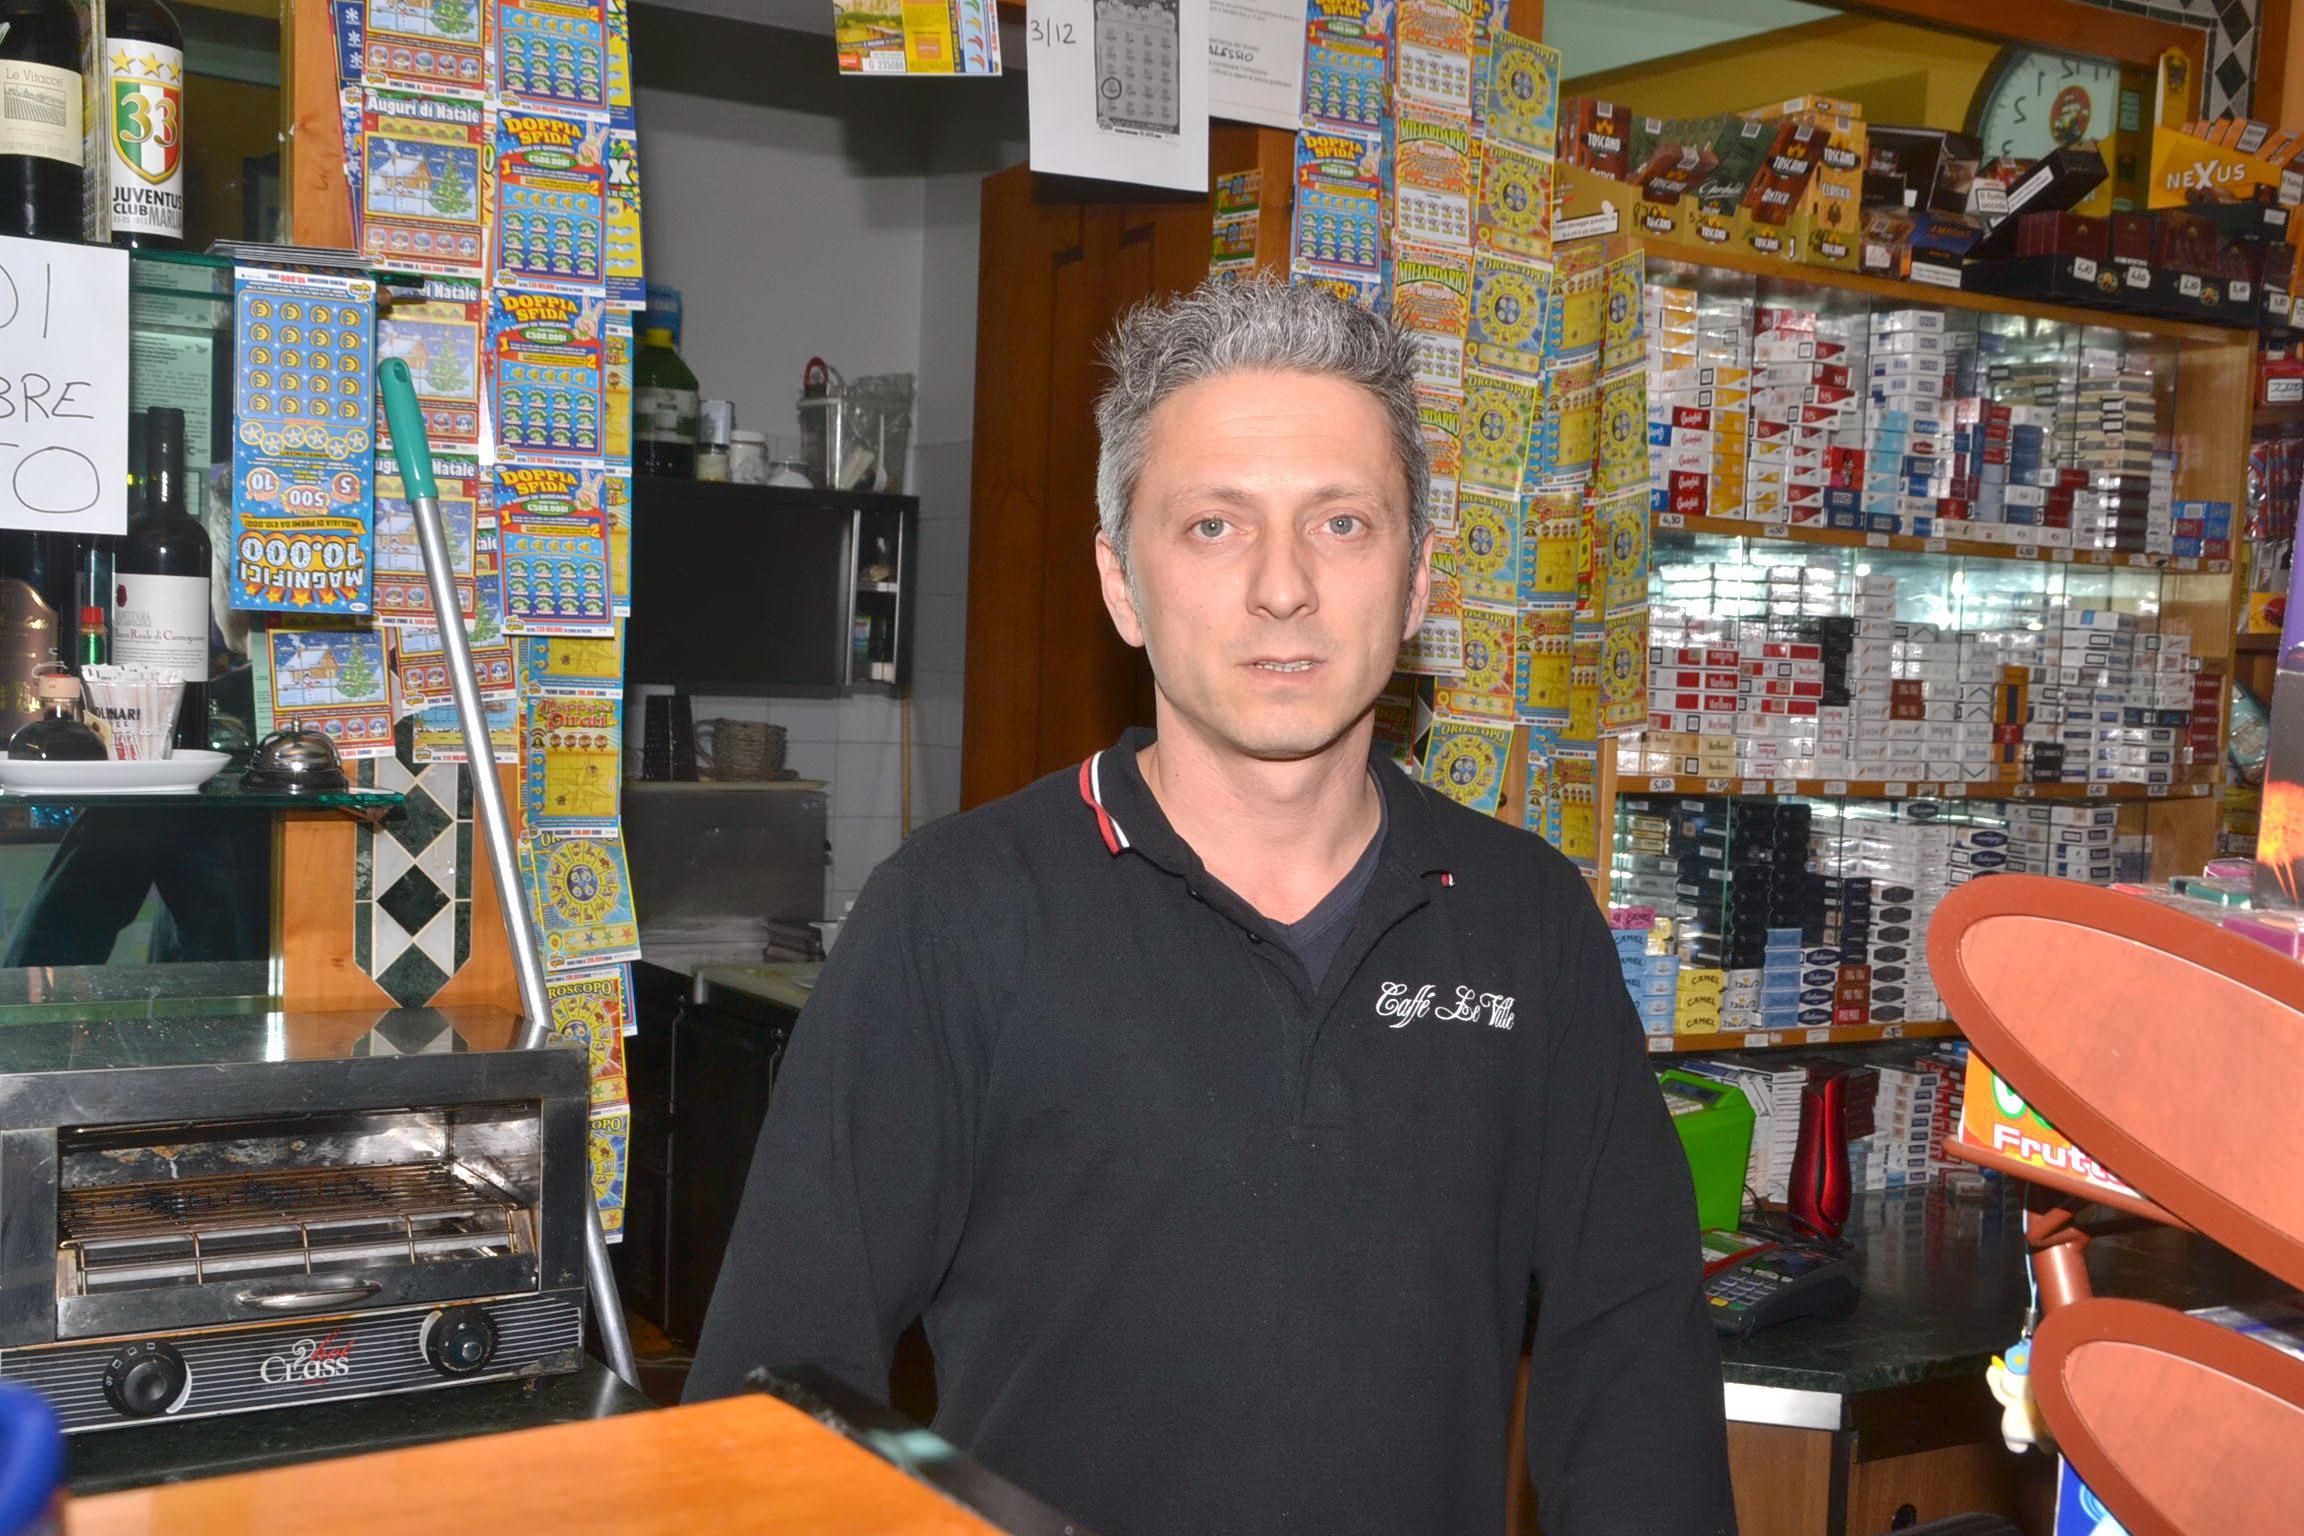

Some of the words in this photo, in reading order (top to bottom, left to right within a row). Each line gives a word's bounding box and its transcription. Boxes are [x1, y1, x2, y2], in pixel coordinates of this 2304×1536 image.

[1030, 18, 1076, 48] 3/12
[1209, 44, 1255, 62] ALESSIO
[6, 67, 20, 81] Le
[367, 93, 417, 116] Auguri
[420, 102, 433, 117] di
[436, 102, 480, 124] Natale
[119, 92, 178, 147] 33
[504, 116, 582, 139] DOPPIA
[518, 131, 572, 147] SFIDA
[1304, 135, 1364, 155] DOPPIA
[1588, 132, 1622, 153] TOSCANO
[1773, 155, 1809, 175] TOSCANO
[1824, 147, 1856, 167] TOSCANO
[2166, 160, 2246, 191] NEXUS
[112, 186, 182, 210] JUVENTUS
[113, 203, 148, 216] CLUB
[1483, 257, 1547, 285] OROSCOPO
[434, 282, 479, 301] Natale
[501, 294, 578, 314] DOPPIA
[516, 308, 569, 323] SFIDA
[1467, 374, 1533, 398] OROSCOPO
[432, 459, 477, 478] Natale
[500, 468, 578, 487] DOPPIA
[251, 472, 275, 491] 10
[340, 476, 353, 494] 5
[515, 480, 569, 496] SFIDA
[289, 489, 325, 507] 500
[241, 537, 363, 569] 10.000
[240, 562, 364, 589] MAGNIFICI
[94, 706, 141, 720] OLINARI
[1440, 722, 1506, 744] OROSCOPO
[1621, 956, 1643, 966] AMEL
[548, 980, 613, 1000] ROSCOPO
[1691, 974, 1721, 986] CAMEL
[1435, 985, 1482, 1023] Le
[1480, 992, 1516, 1031] Ville
[1687, 995, 1716, 1007] CAMEL
[1686, 1016, 1715, 1029] CAMEL
